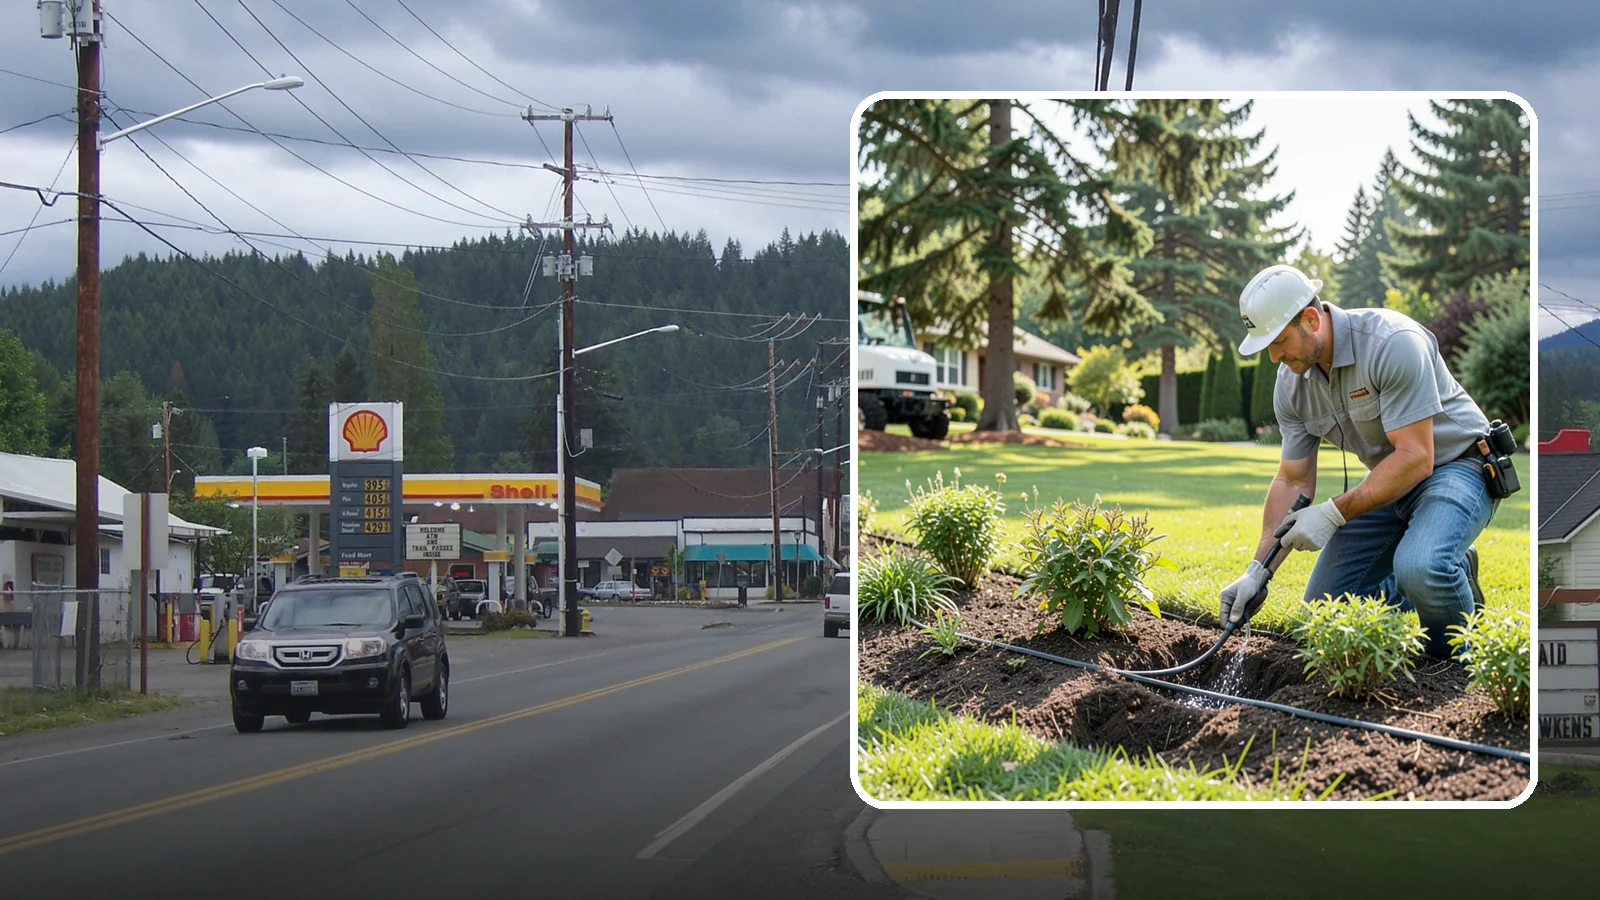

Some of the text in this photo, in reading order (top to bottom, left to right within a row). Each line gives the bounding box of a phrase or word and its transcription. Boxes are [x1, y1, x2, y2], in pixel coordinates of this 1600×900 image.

[365, 480, 383, 490] 395
[490, 484, 547, 499] Shell
[365, 494, 383, 504] 405
[365, 508, 383, 518] 415
[365, 522, 383, 532] 429
